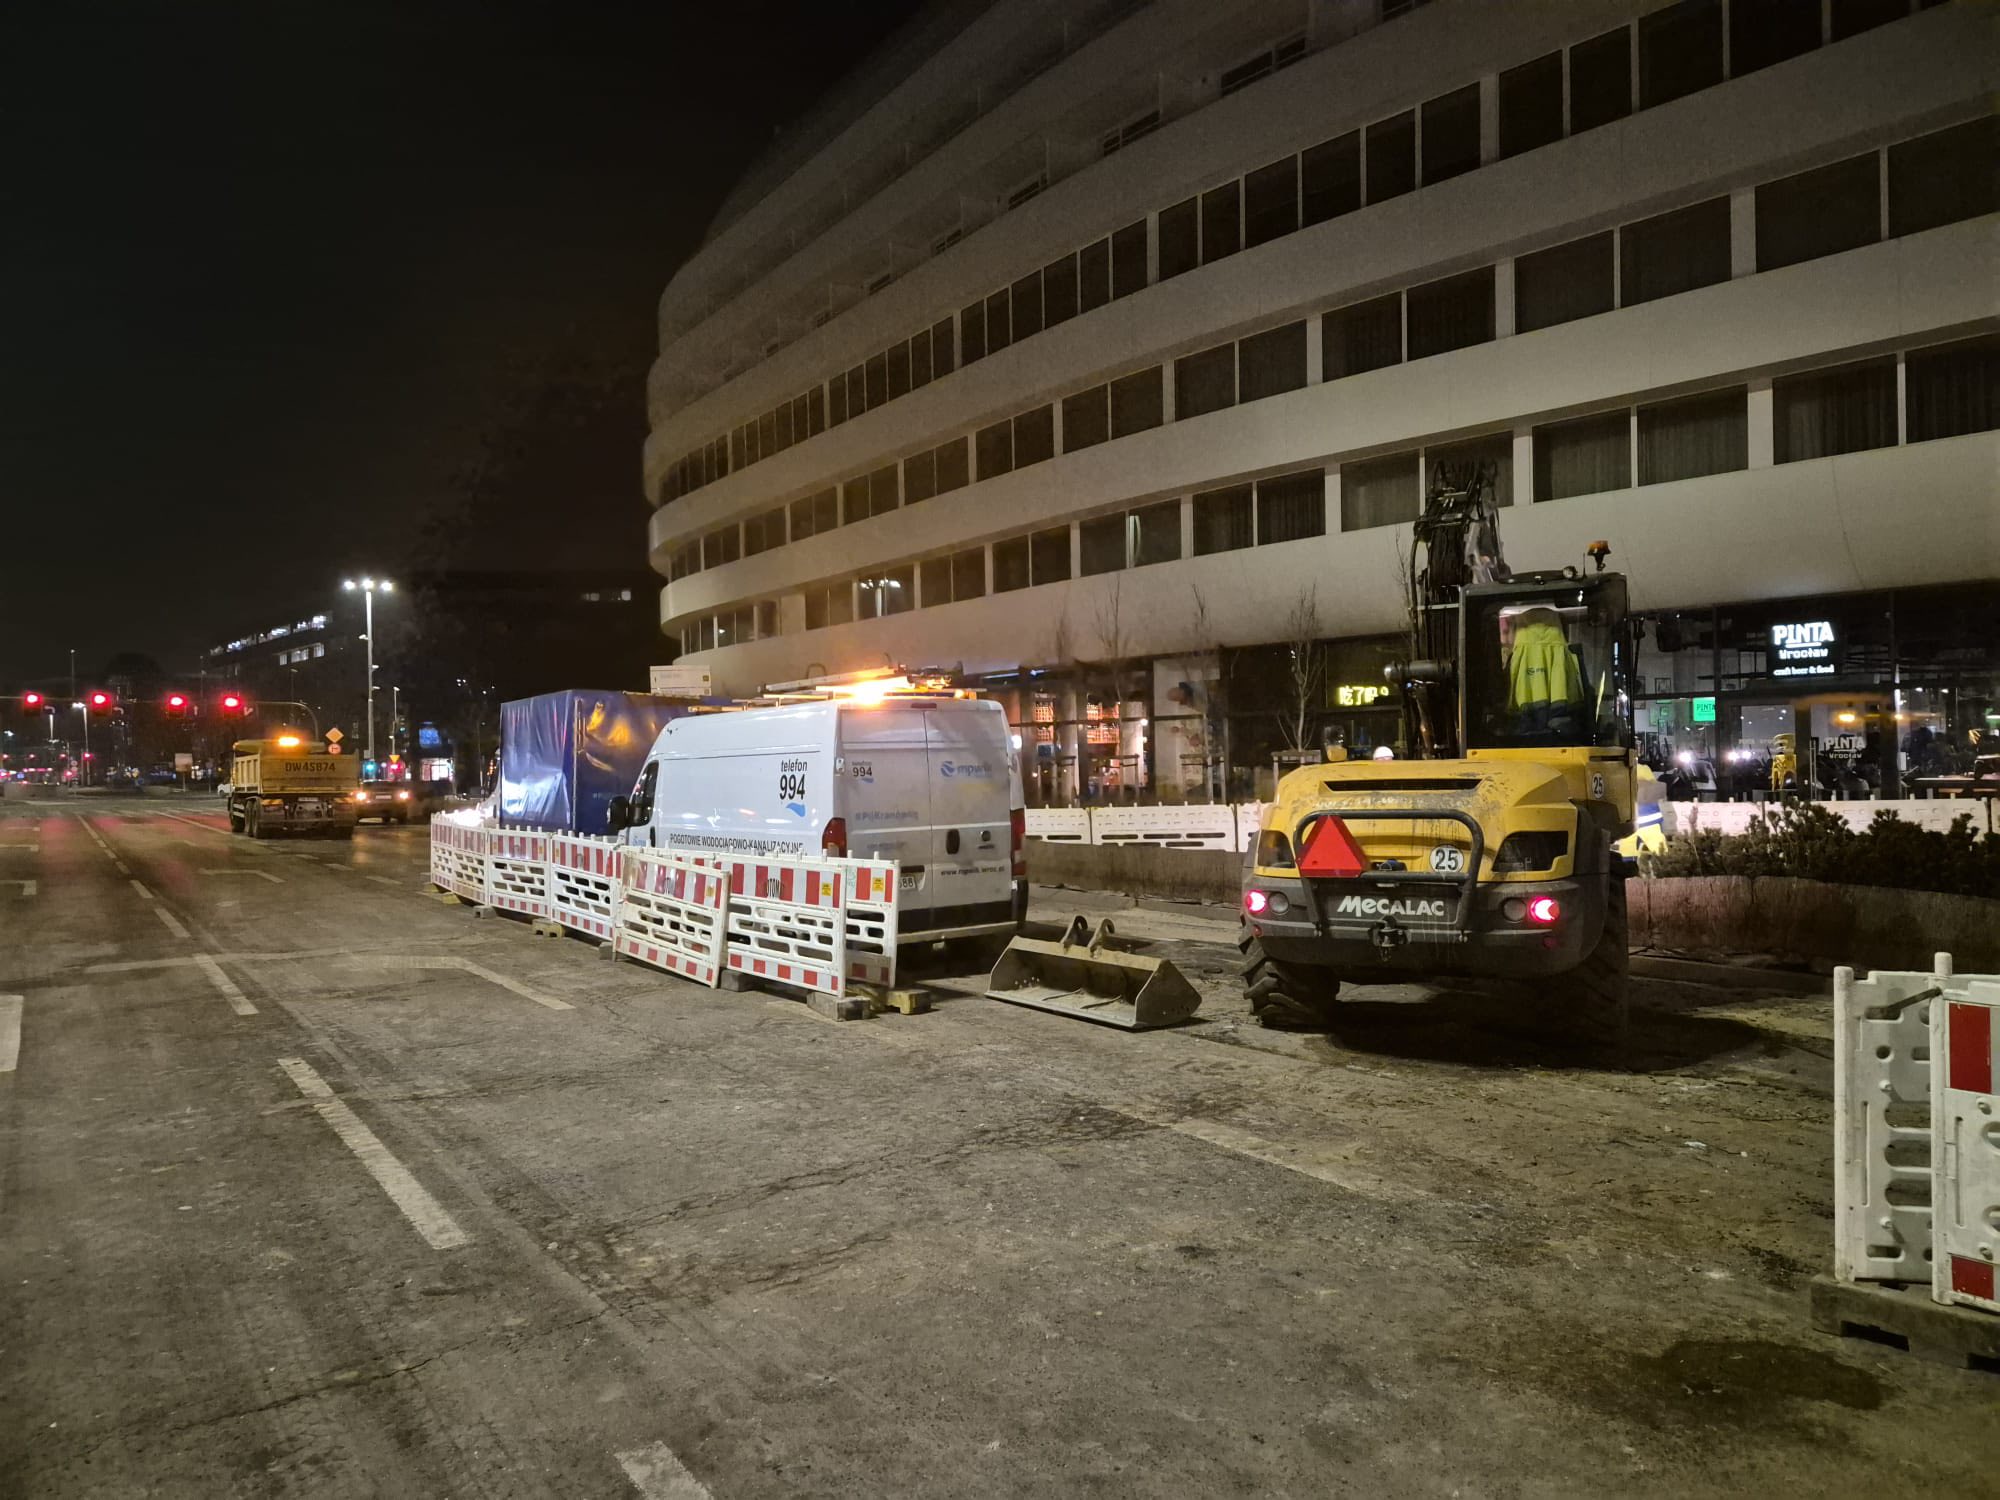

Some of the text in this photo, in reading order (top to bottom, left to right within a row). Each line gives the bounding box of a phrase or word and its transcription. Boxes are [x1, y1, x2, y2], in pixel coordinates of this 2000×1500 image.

[1772, 621, 1835, 645] PINTA
[1824, 736, 1867, 751] PINTA
[780, 759, 808, 773] telefon
[852, 766, 873, 778] 994
[779, 774, 806, 800] 994
[1593, 776, 1603, 794] 25
[670, 833, 701, 846] POGOTOWIE
[1435, 849, 1459, 870] 25
